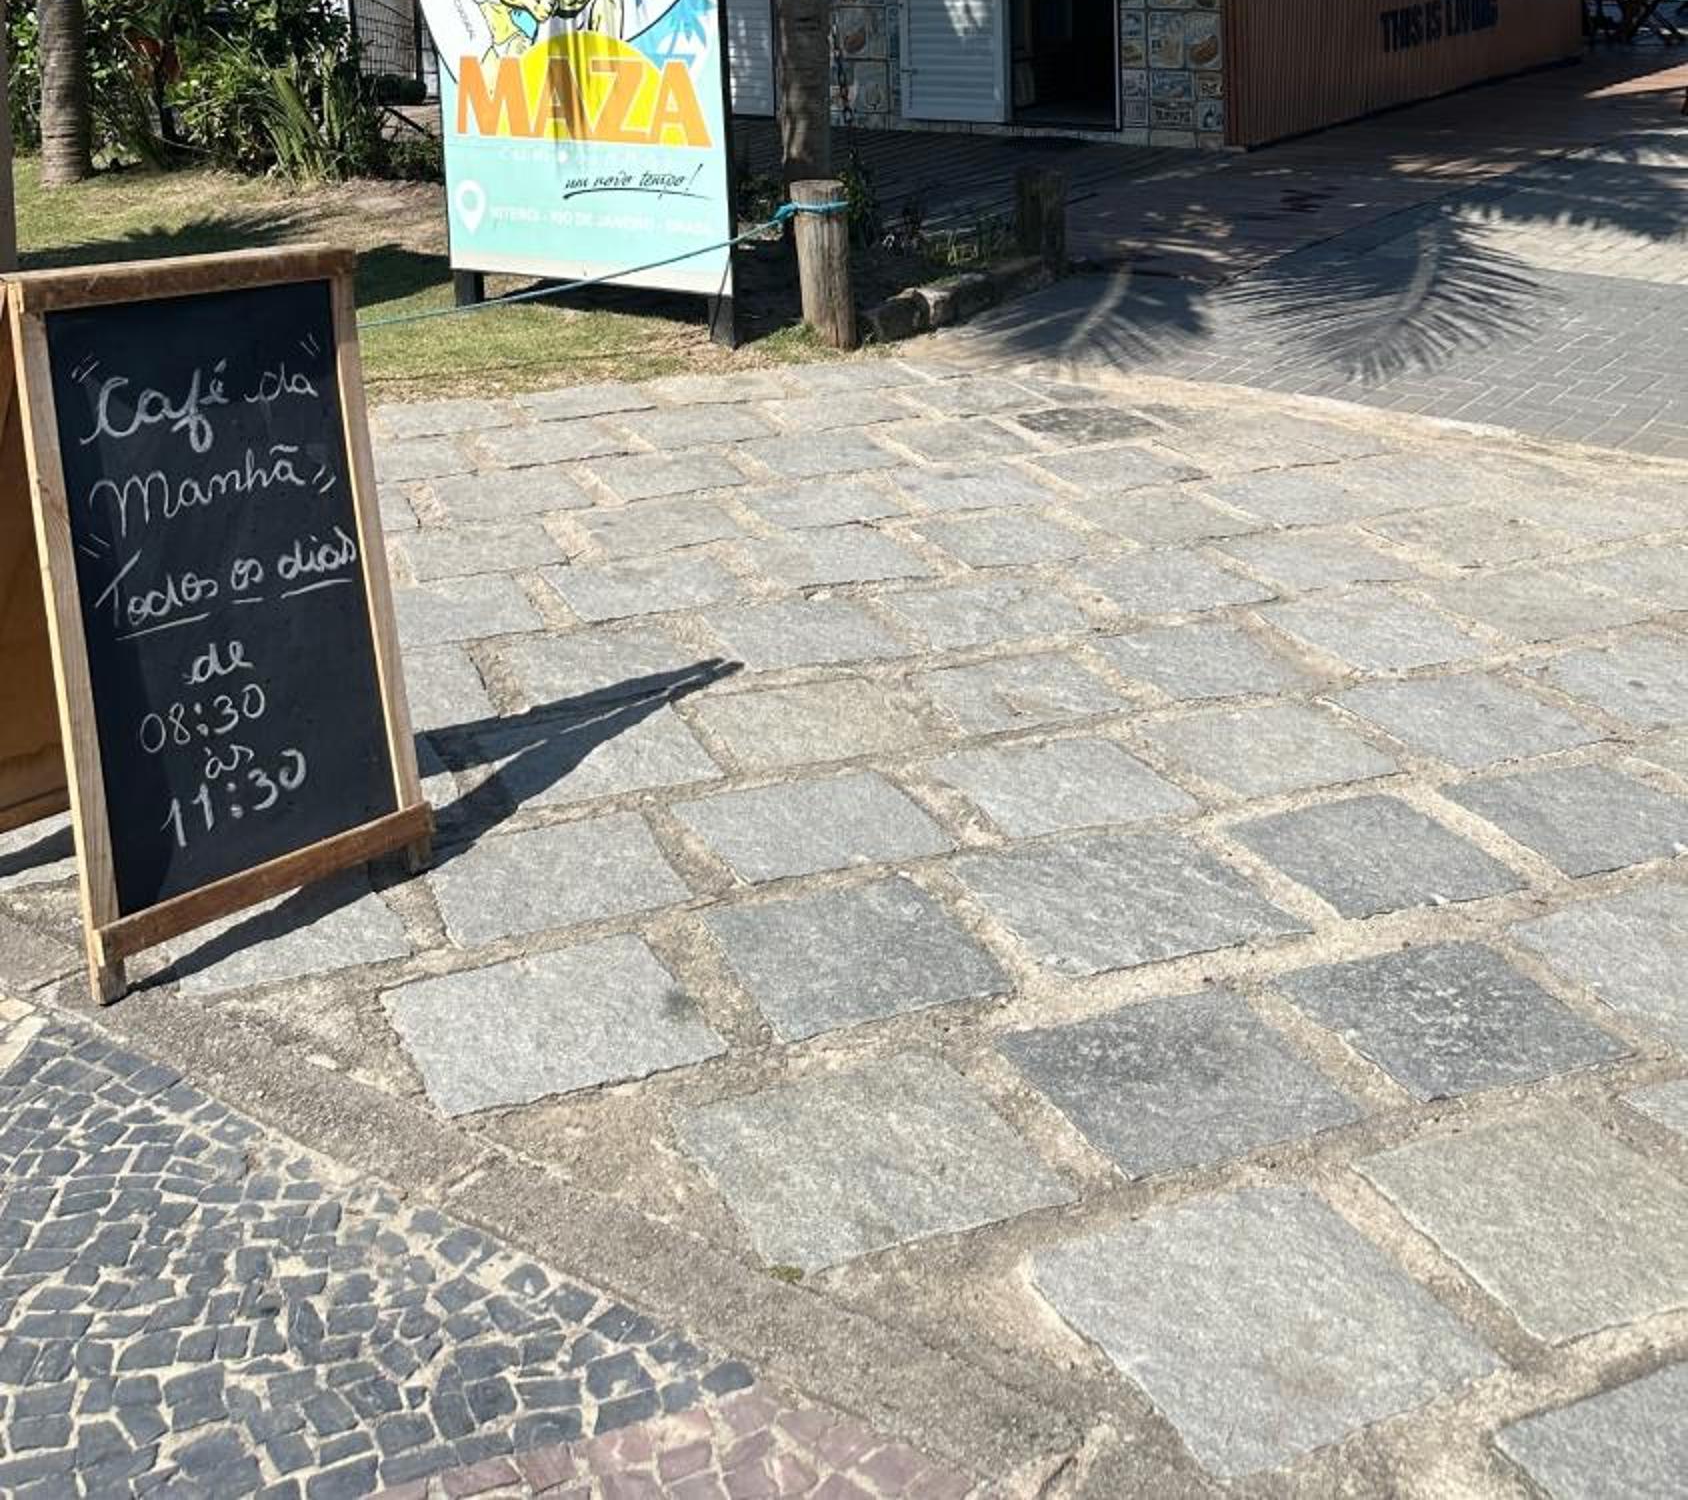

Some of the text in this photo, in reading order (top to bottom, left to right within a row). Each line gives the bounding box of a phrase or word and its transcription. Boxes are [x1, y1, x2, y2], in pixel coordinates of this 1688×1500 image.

[1380, 3, 1423, 52] THIS
[457, 56, 712, 148] MAZA
[80, 358, 319, 452] Café da
[89, 443, 306, 538] Manhã
[95, 525, 358, 627] Todos os dias
[182, 641, 254, 685] de
[140, 683, 266, 753] 08:30
[205, 746, 255, 779] às
[160, 749, 307, 847] 11:30
